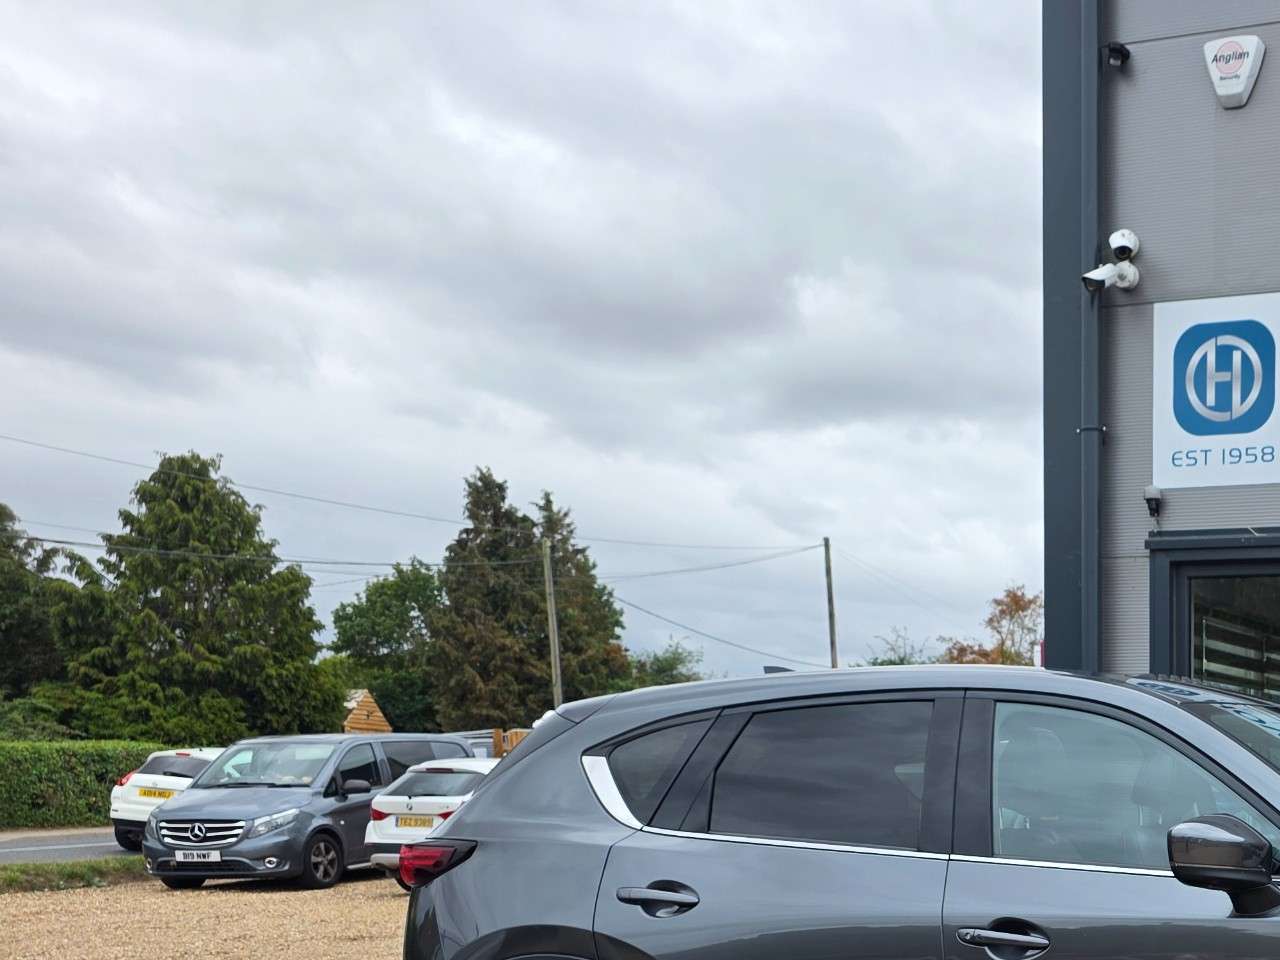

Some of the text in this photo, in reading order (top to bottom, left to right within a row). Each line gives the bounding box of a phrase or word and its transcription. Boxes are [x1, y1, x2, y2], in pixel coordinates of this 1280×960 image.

[1211, 51, 1249, 64] Anglian
[1171, 445, 1275, 467] EST 1958
